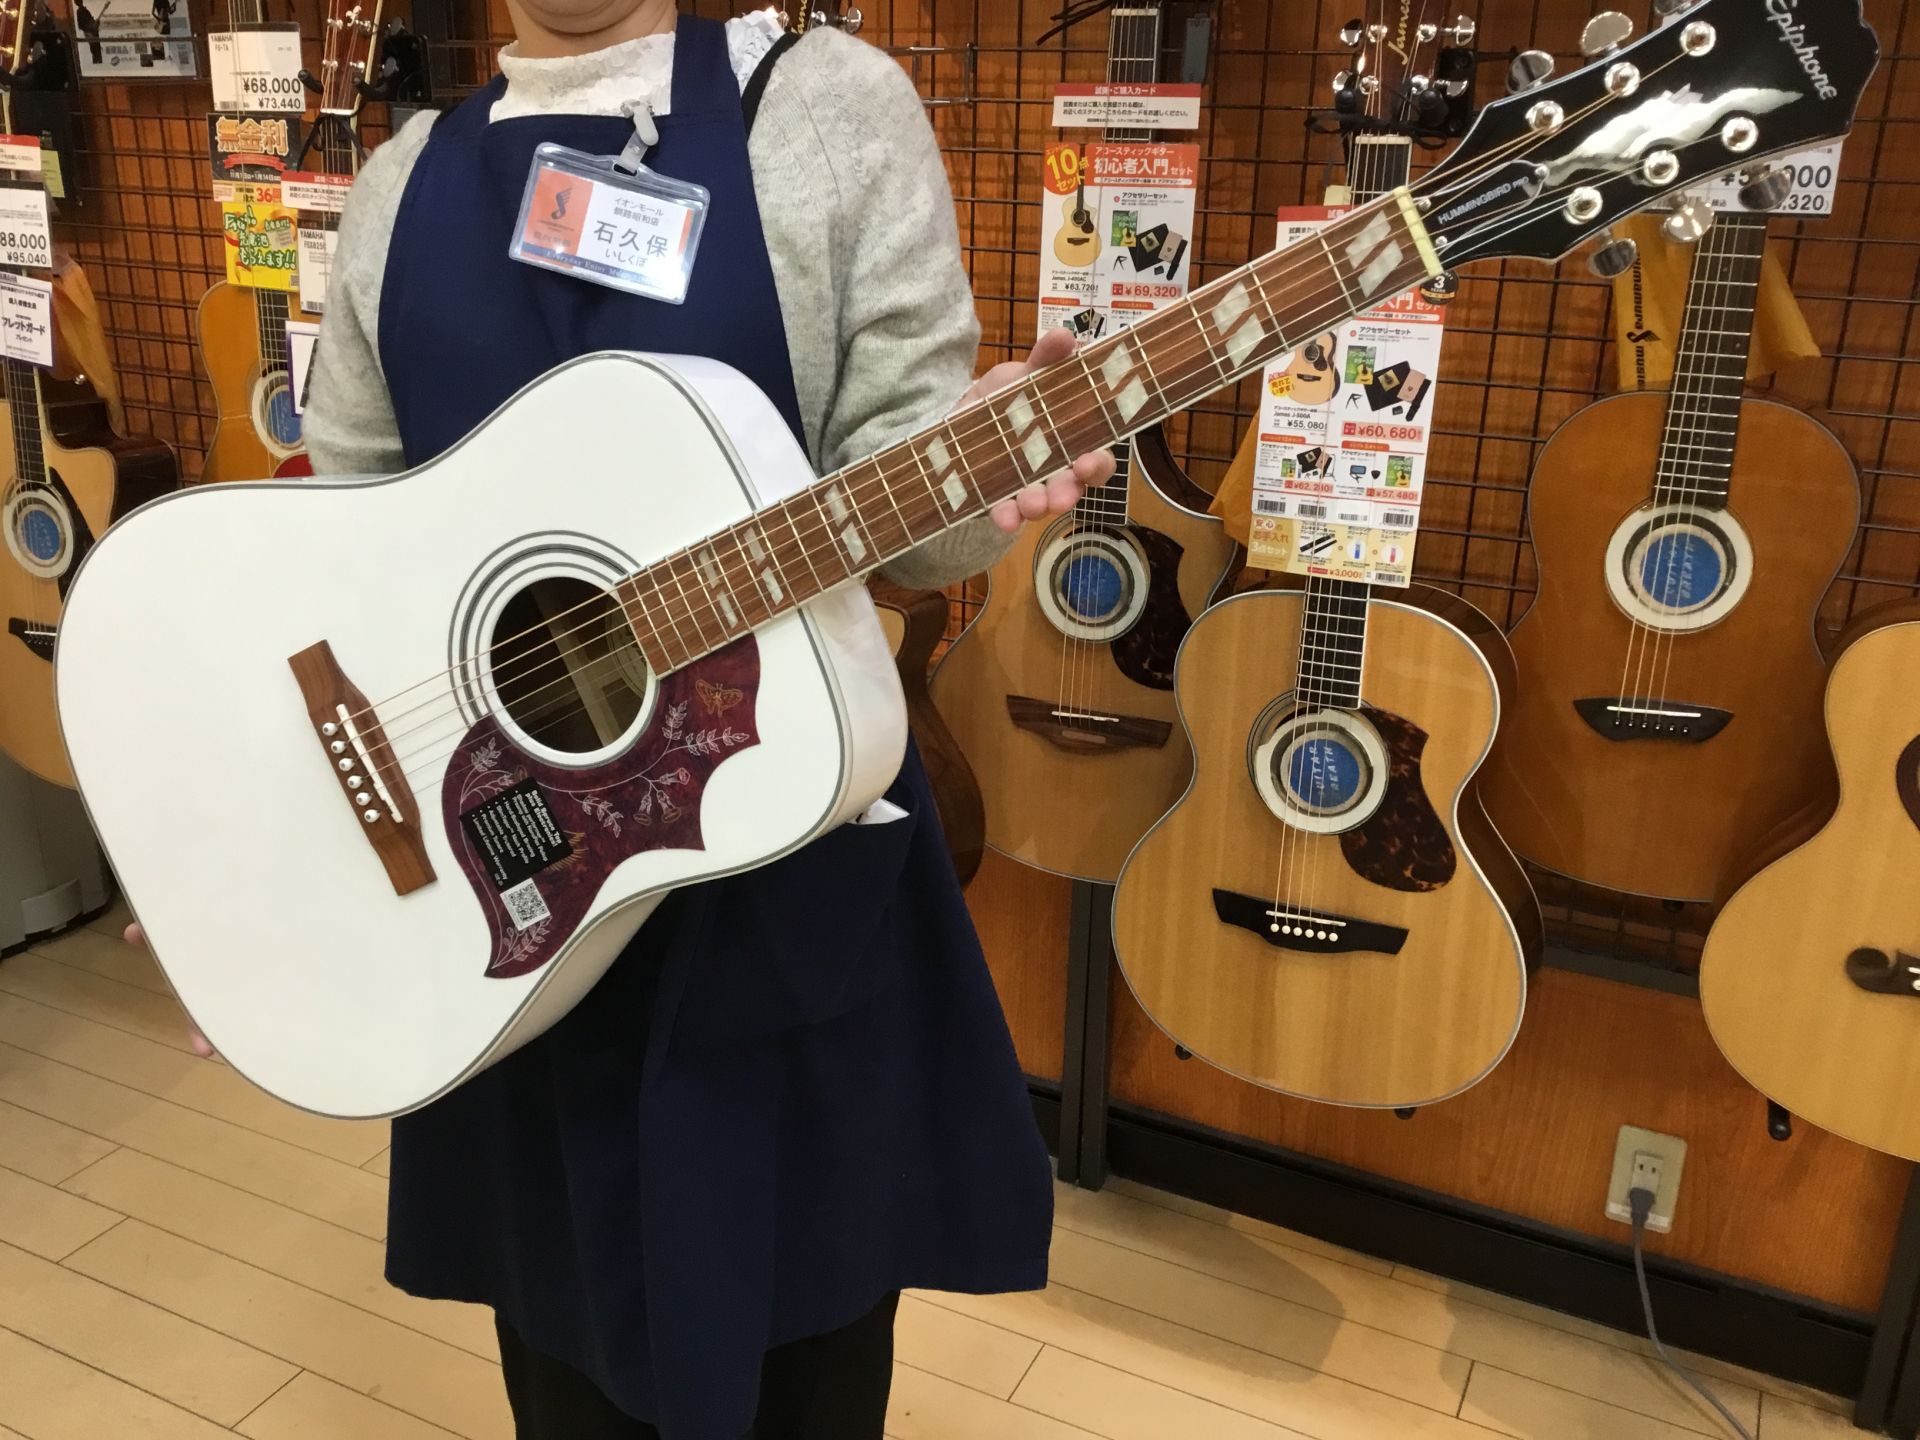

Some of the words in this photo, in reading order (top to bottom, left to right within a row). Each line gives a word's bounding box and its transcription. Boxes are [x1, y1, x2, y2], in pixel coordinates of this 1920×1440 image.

[1764, 0, 1838, 101] Epiphone
[243, 77, 301, 94] ¥68,000
[258, 97, 301, 110] ¥73,440
[215, 116, 290, 156] 無金利
[1093, 158, 1169, 176] 初心者入門
[1170, 166, 1194, 176] セット
[1055, 174, 1086, 193] セット
[614, 196, 664, 217] イオンモール
[1438, 182, 1512, 224] HUMMINGBIRD
[300, 229, 324, 240] YAMAHA
[593, 219, 670, 258] 石久保
[7, 251, 47, 265] ¥95,040
[604, 248, 648, 268] いしくぼ
[1125, 284, 1178, 298] ¥69,320
[1434, 275, 1446, 289] 3
[1, 316, 46, 336] フレットガード
[1287, 419, 1325, 430] ¥55,080
[1358, 426, 1417, 440] ¥60,680
